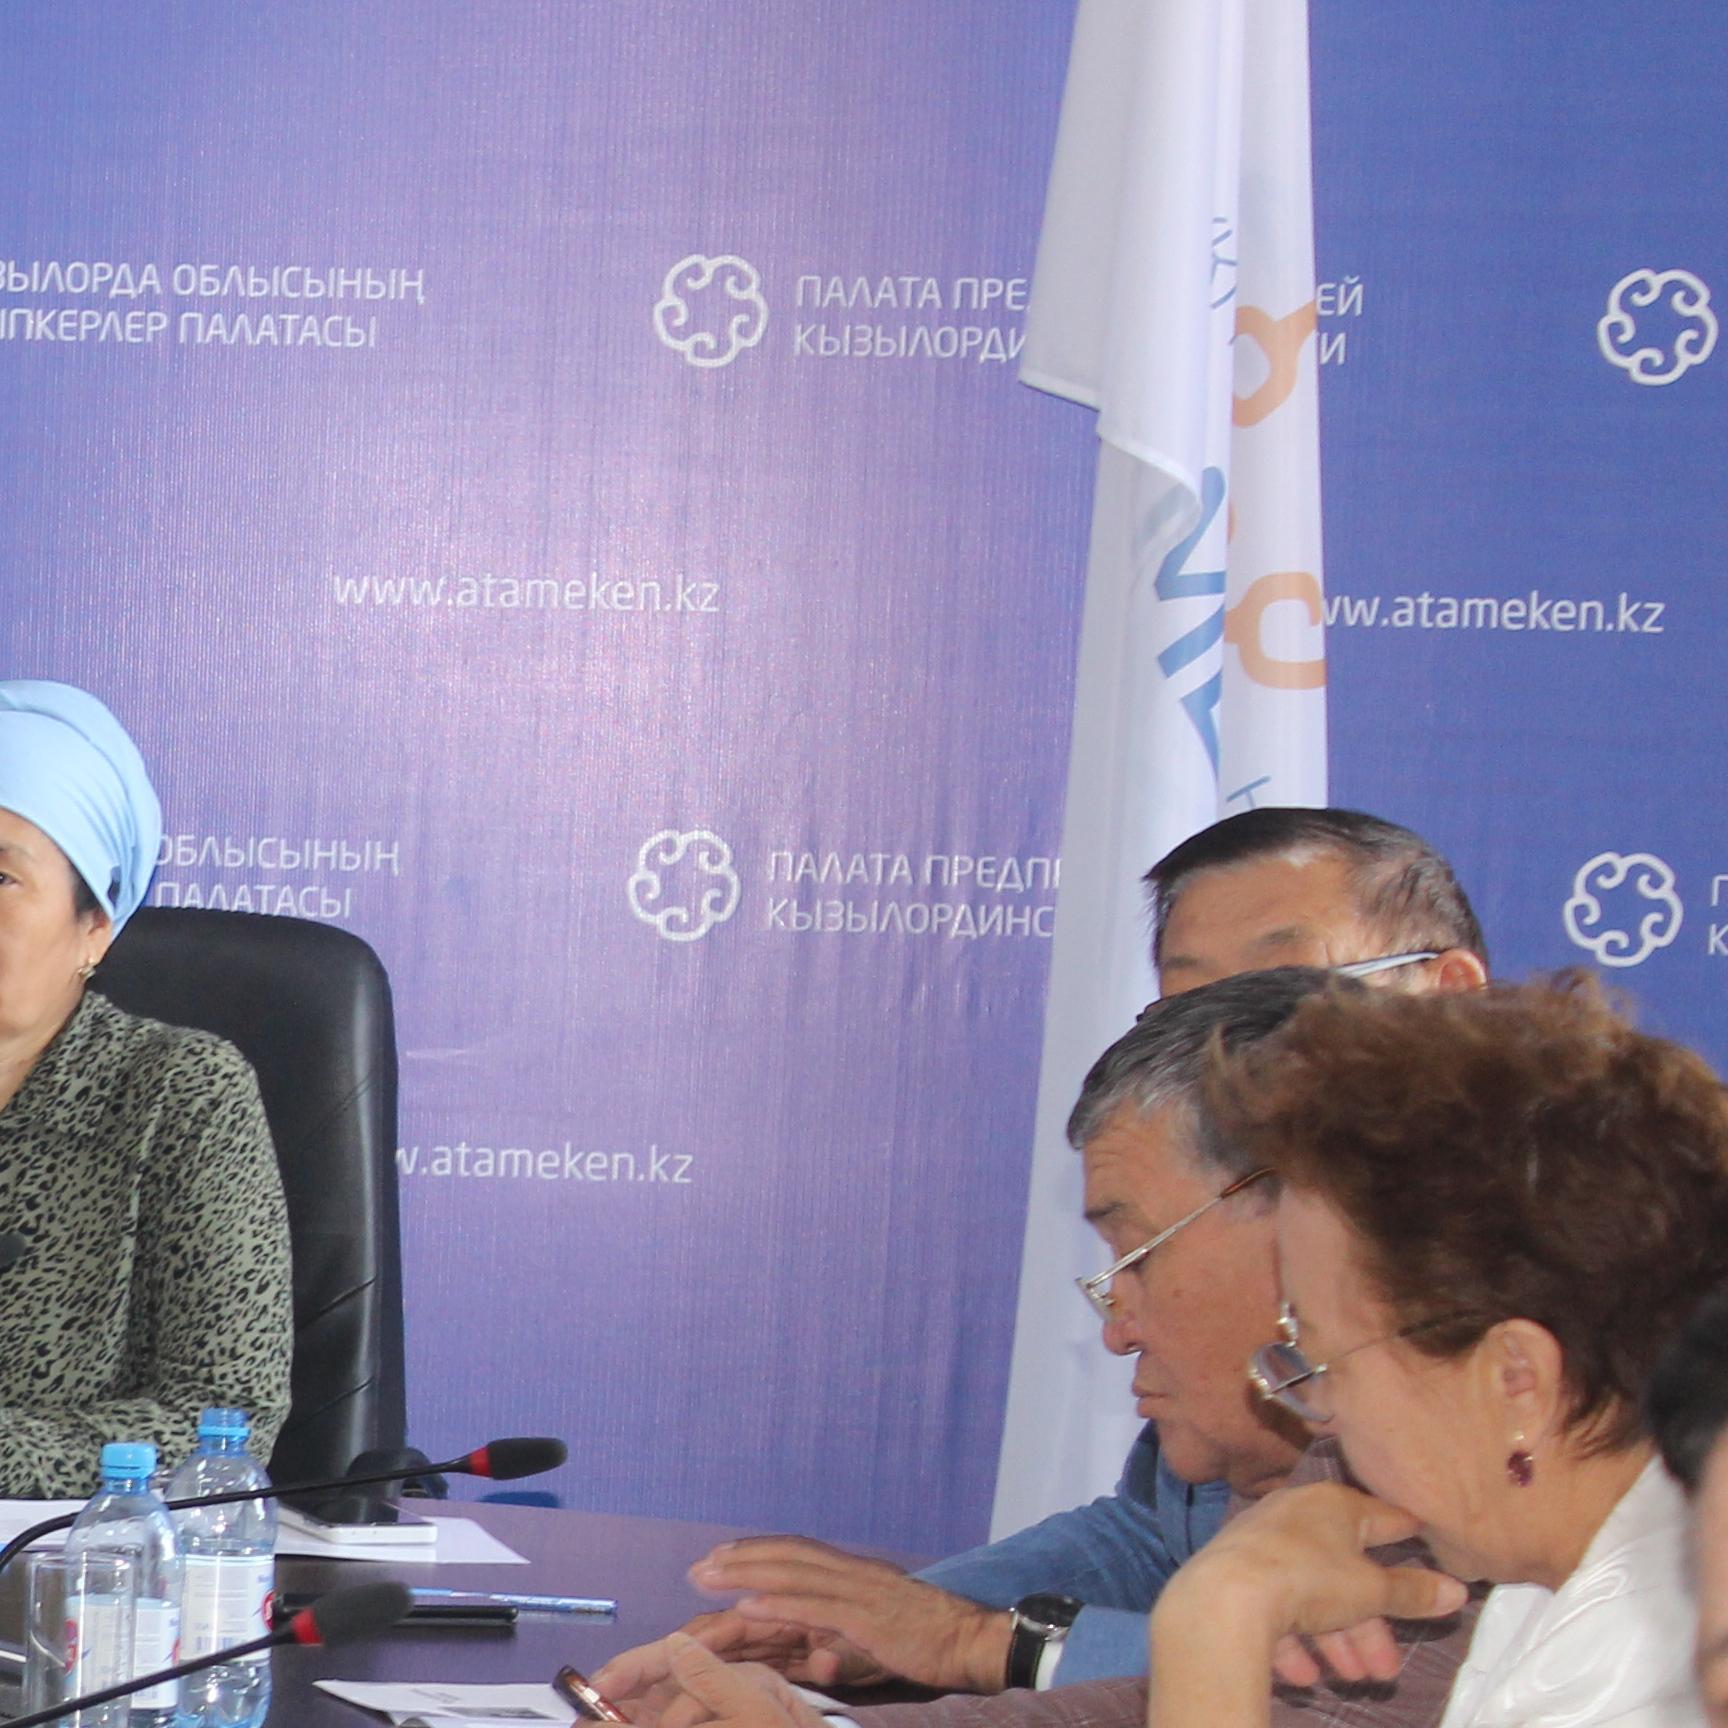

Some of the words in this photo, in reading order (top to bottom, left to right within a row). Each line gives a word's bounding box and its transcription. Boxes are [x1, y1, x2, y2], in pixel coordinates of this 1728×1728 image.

[173, 264, 425, 304] ОБЛЫСЫНЫҢ
[797, 276, 941, 308] ПАЛАТА
[180, 313, 375, 347] ПАЛАТАСЫ
[334, 573, 717, 611] www.atameken.kz
[1324, 590, 1666, 633] w.atameken.kz
[767, 849, 911, 885] ПАЛАТА
[154, 882, 350, 918] ПАЛАТАСЫ
[765, 898, 1054, 940] КЫЗЫЛОРДИНС
[397, 1142, 692, 1183] w.atameken.kz
